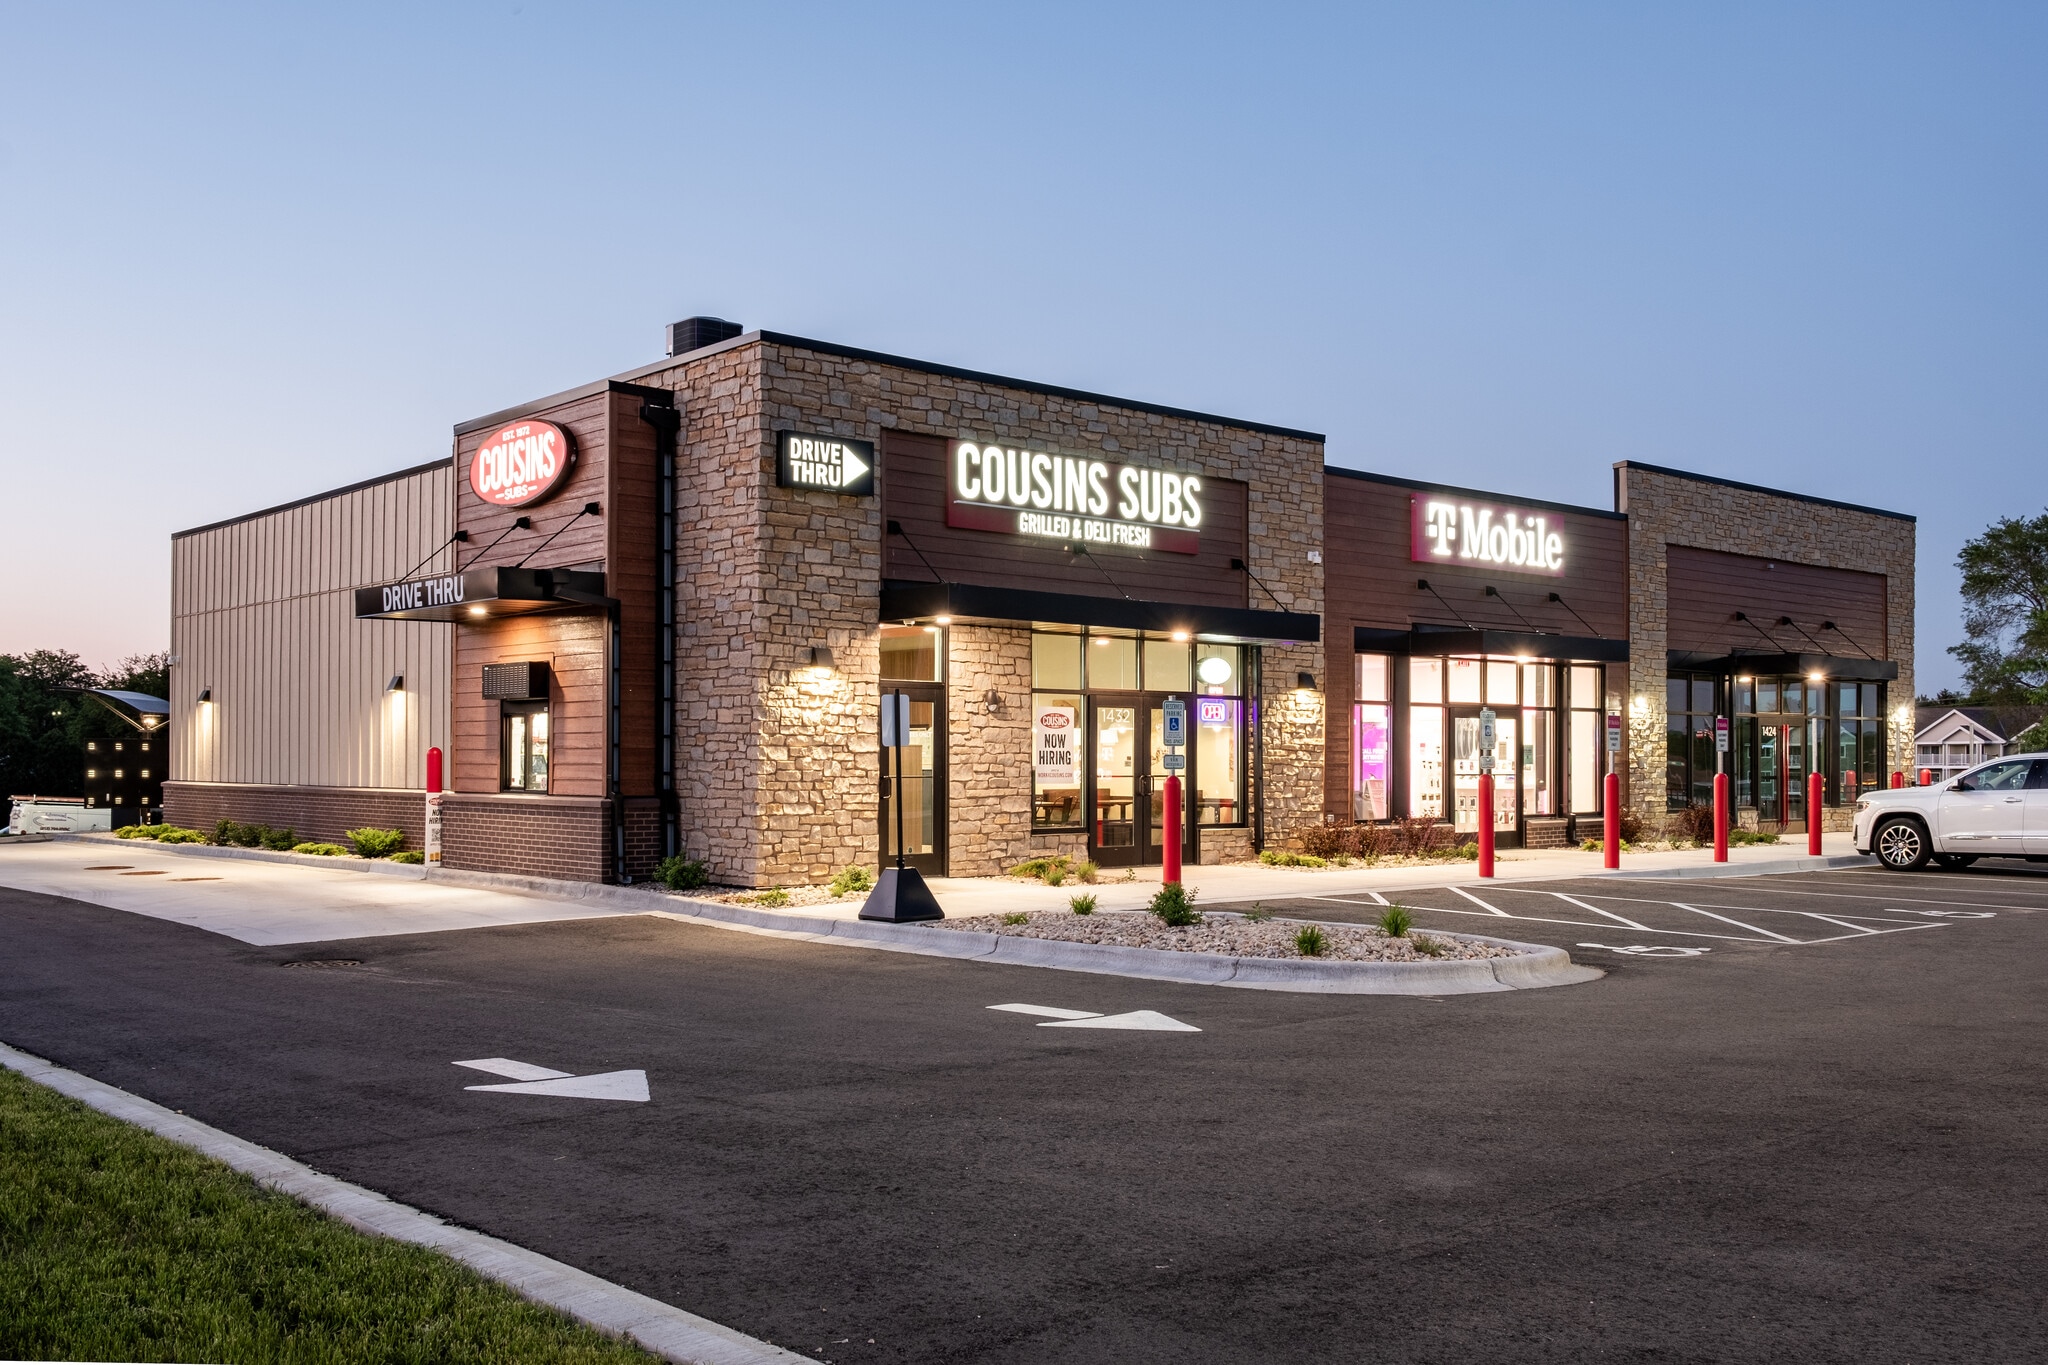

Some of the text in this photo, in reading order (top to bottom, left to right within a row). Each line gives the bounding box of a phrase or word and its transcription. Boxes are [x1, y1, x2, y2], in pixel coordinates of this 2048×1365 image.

[790, 437, 841, 465] DRIVE
[479, 430, 556, 493] COUSINS
[790, 460, 841, 487] THRU
[504, 484, 528, 500] SUBS
[957, 443, 1201, 527] COUSINS SUBS
[1019, 512, 1150, 547] GRILLED & DELI FRESH
[383, 576, 464, 611] DRIVE THRU
[1101, 709, 1131, 723] 1432
[1203, 705, 1222, 719] OPEN
[1042, 716, 1068, 726] COUSINS
[1762, 726, 1777, 736] 1424
[1044, 734, 1066, 748] NOW
[1038, 750, 1071, 765] HIRING
